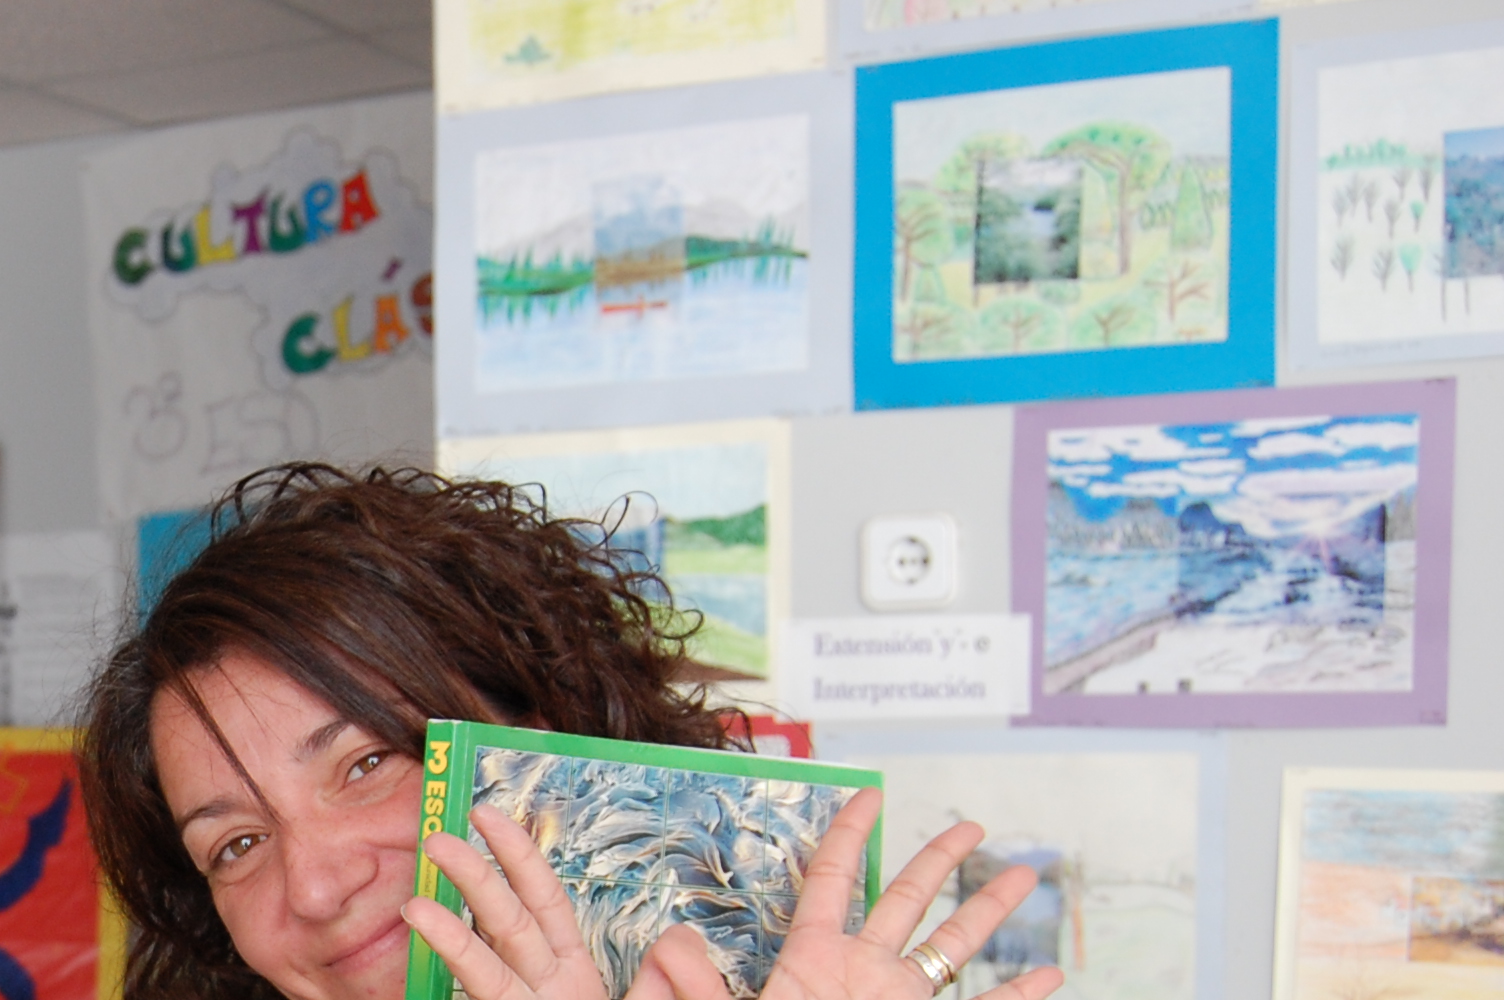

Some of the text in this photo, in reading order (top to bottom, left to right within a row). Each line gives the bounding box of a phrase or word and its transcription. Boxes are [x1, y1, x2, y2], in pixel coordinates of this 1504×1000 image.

[113, 168, 381, 287] CULTURA
[813, 632, 933, 656] Extensión
[813, 675, 986, 706] Interpretación
[423, 740, 451, 834] 3 ESO
